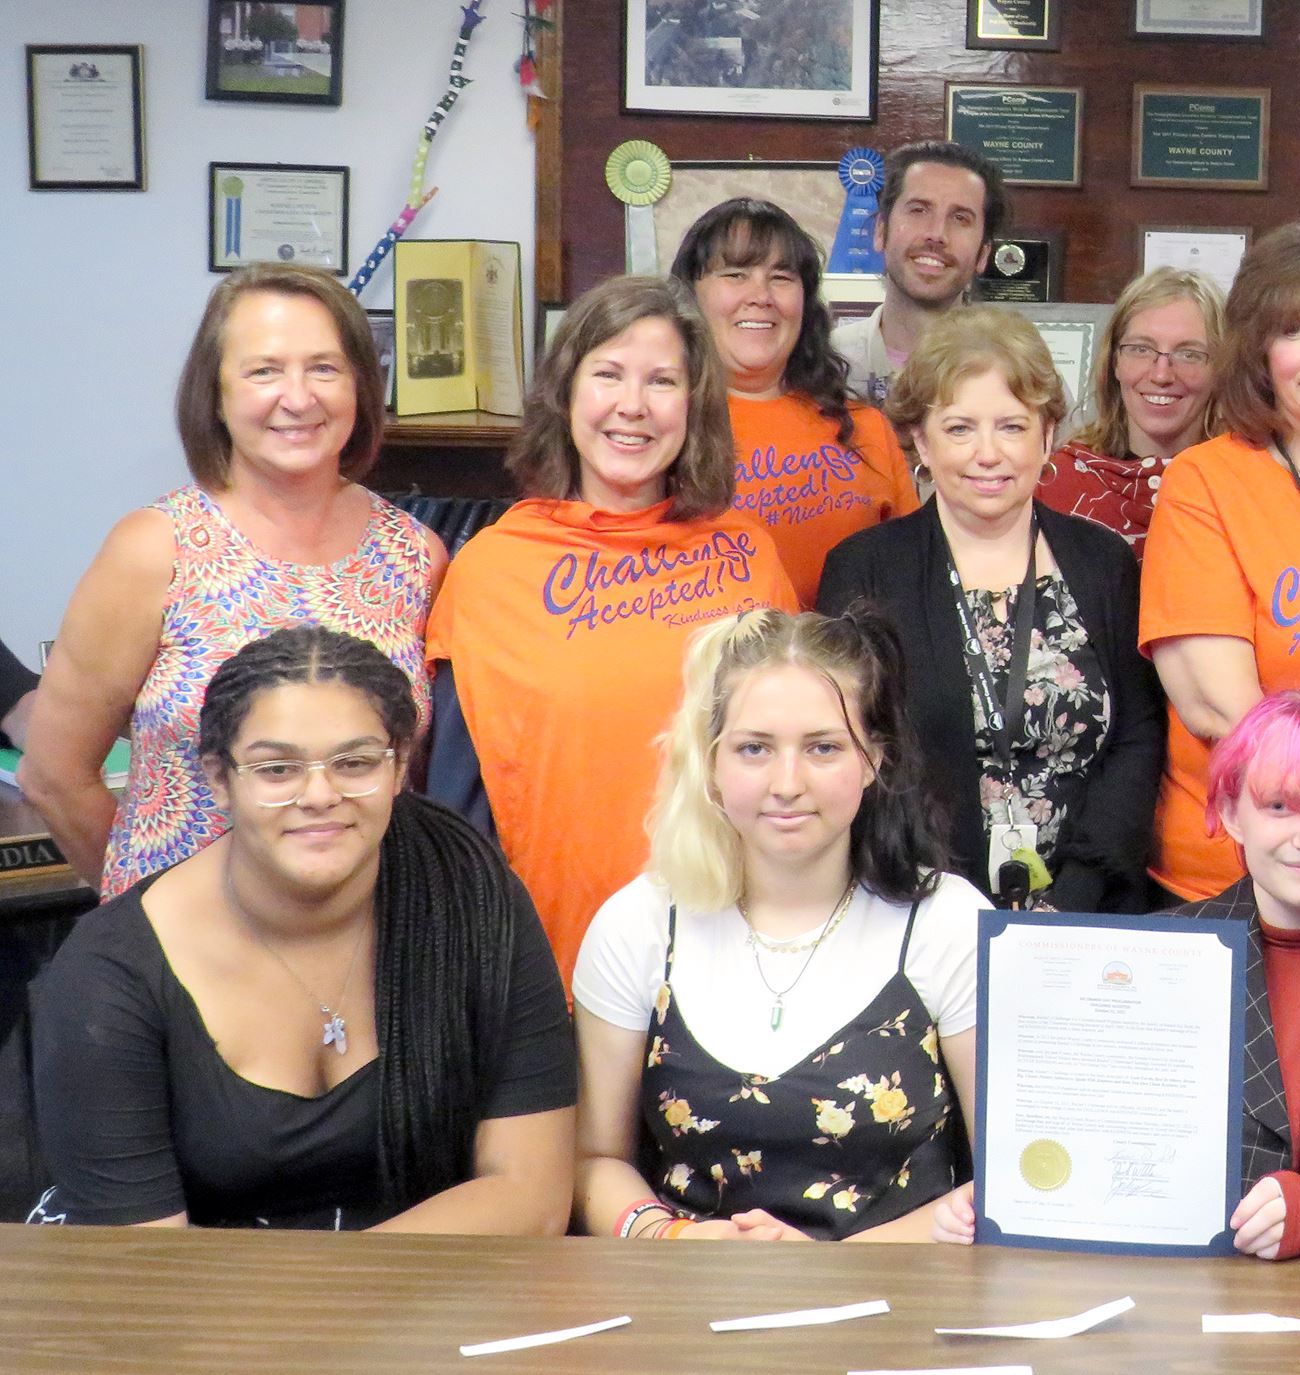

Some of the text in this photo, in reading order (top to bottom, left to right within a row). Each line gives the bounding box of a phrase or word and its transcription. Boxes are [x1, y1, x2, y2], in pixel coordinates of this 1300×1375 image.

[983, 140, 1044, 149] WAYNE COUNTY
[1168, 147, 1233, 156] WAYNE COUNTY
[734, 445, 862, 481] allenge
[731, 469, 828, 517] cepted!
[543, 531, 756, 615] Challenge
[566, 560, 725, 640] Accepted!
[0, 844, 56, 867] DIA
